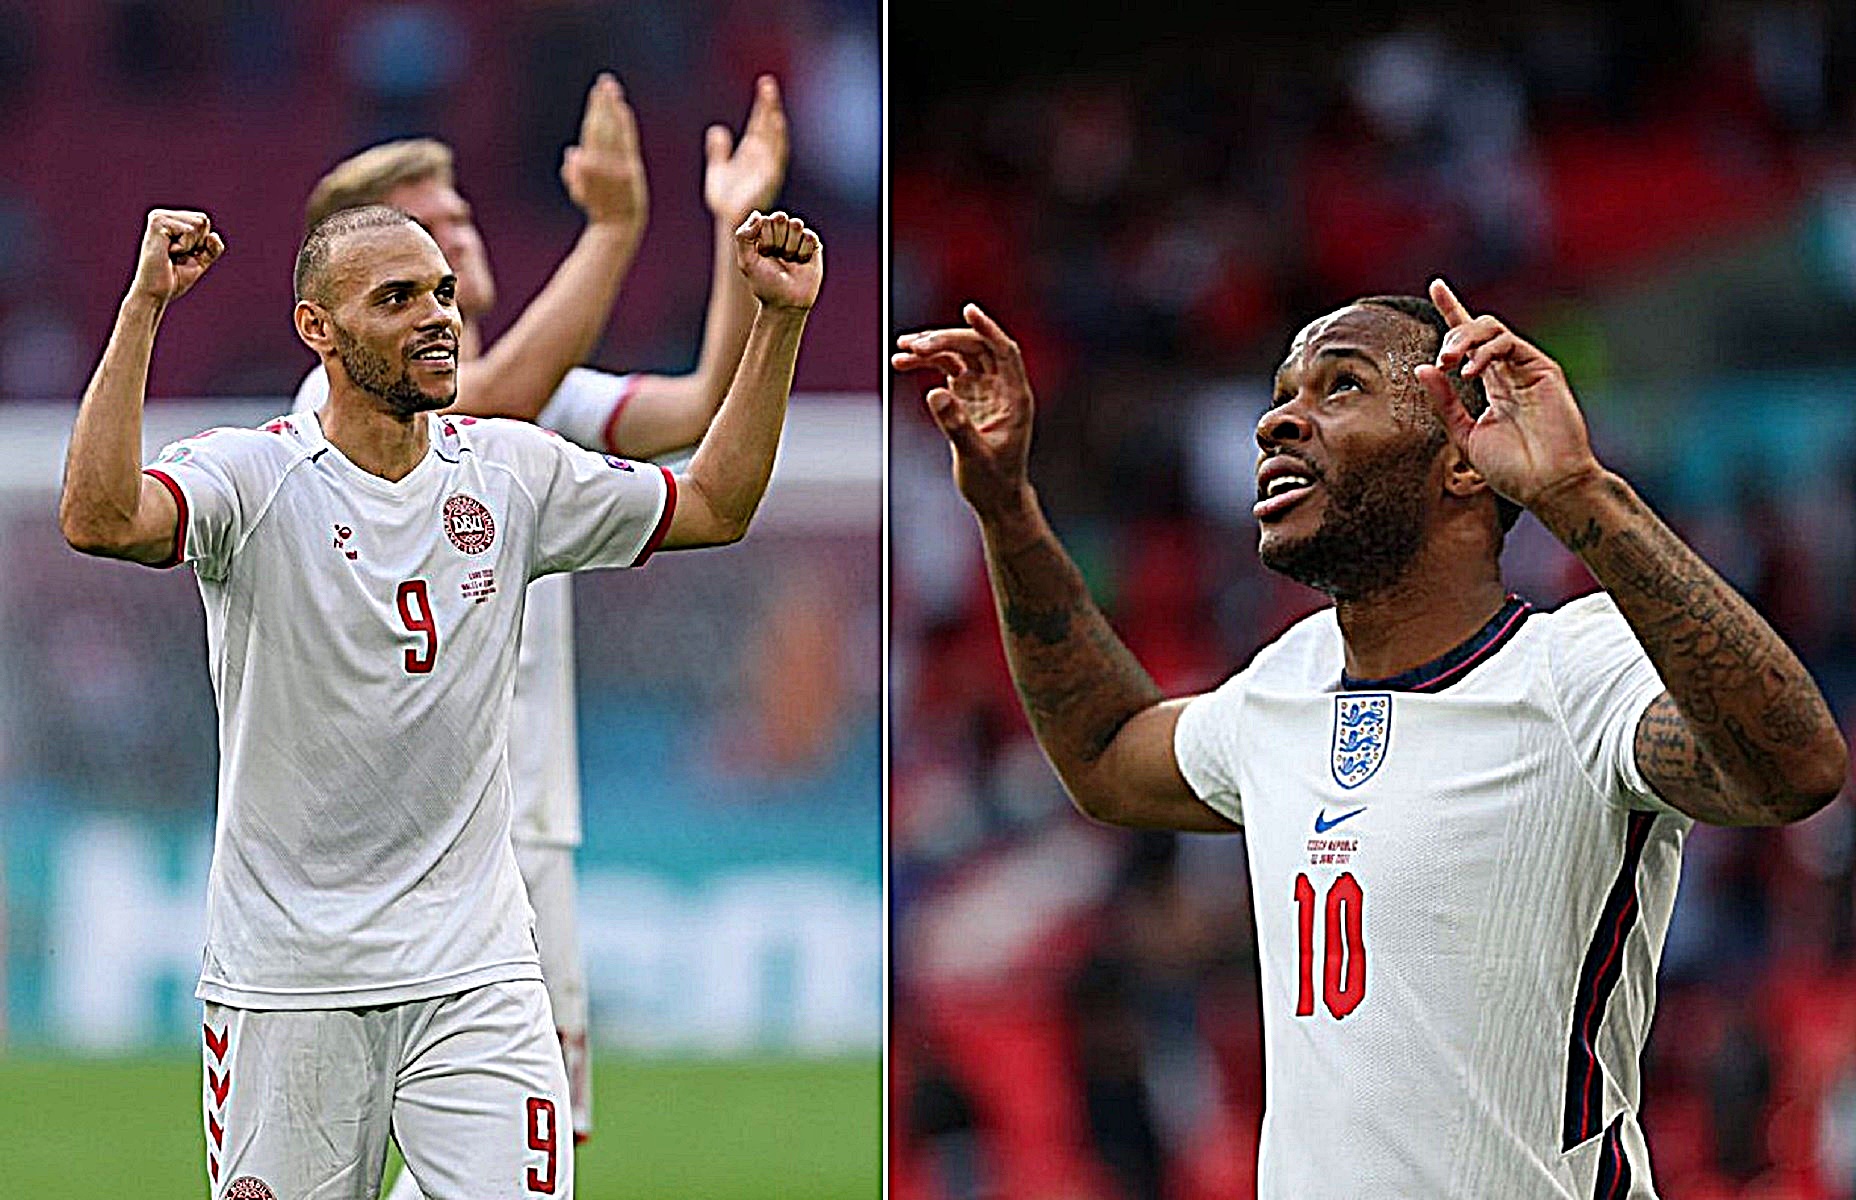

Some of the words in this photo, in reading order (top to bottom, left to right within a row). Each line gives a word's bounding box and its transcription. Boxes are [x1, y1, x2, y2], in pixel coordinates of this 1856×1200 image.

[451, 514, 485, 534] DBU
[396, 579, 438, 674] 9
[1306, 839, 1328, 851] CZECH
[1328, 839, 1359, 851] REPUBLIC
[1319, 853, 1336, 865] JUNE
[1293, 871, 1367, 1021] 10
[526, 1096, 557, 1196] 9
